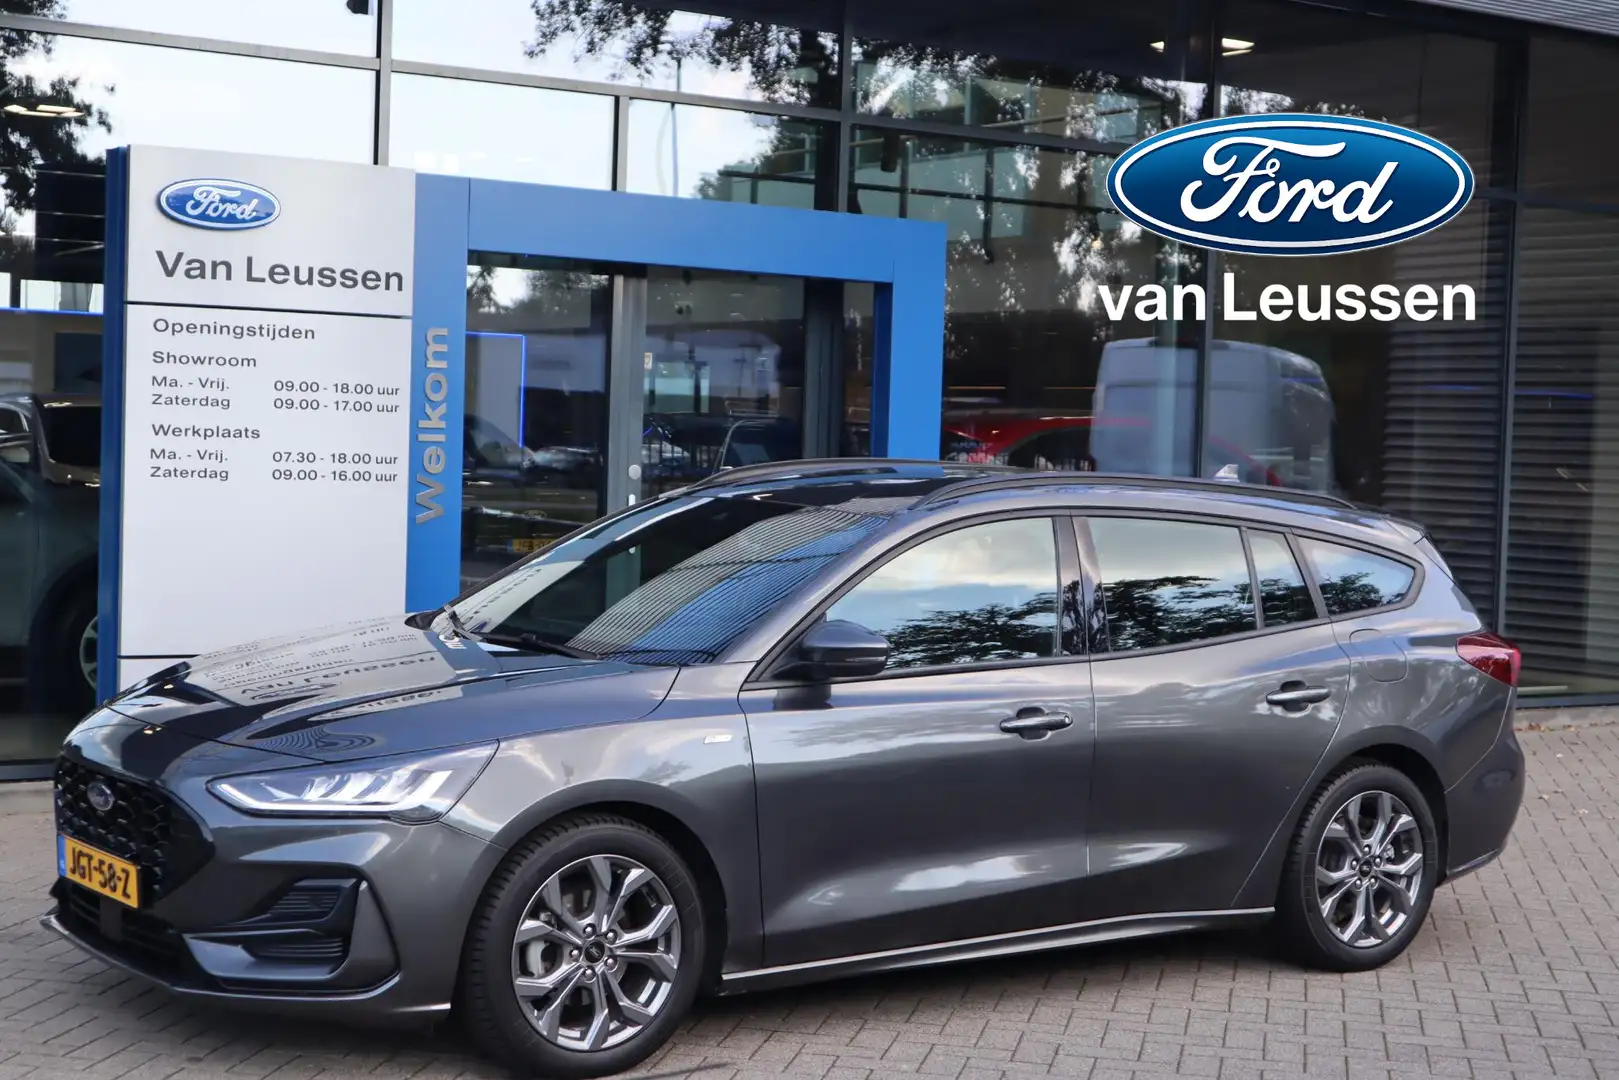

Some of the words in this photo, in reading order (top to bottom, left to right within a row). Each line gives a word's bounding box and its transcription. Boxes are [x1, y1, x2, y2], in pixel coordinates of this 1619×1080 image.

[185, 186, 260, 221] Ford
[155, 250, 232, 281] Van
[246, 255, 404, 292] Leussen
[153, 318, 316, 341] Openingstijden
[152, 351, 257, 368] Showroom
[151, 375, 183, 388] Ma.
[198, 377, 230, 392] Vrij.
[273, 380, 320, 393] 09.00
[333, 383, 374, 395] 18.00
[377, 386, 400, 396] uur
[151, 393, 231, 410] Zaterdag
[273, 398, 320, 411] 09.00
[334, 400, 373, 413] 17.00
[377, 403, 399, 413] uur
[151, 424, 261, 441] Werkplaats
[415, 326, 449, 525] Welkom
[150, 449, 182, 461] Ma.
[196, 450, 228, 464] Vrij.
[272, 451, 316, 464] 07.30
[330, 453, 372, 465] 18.00
[375, 455, 398, 465] uur
[150, 466, 229, 482] Zaterdag
[272, 469, 318, 481] 09.00
[331, 470, 372, 482] 16.00
[375, 473, 398, 483] uur
[69, 847, 131, 900] JGT-58-Z
